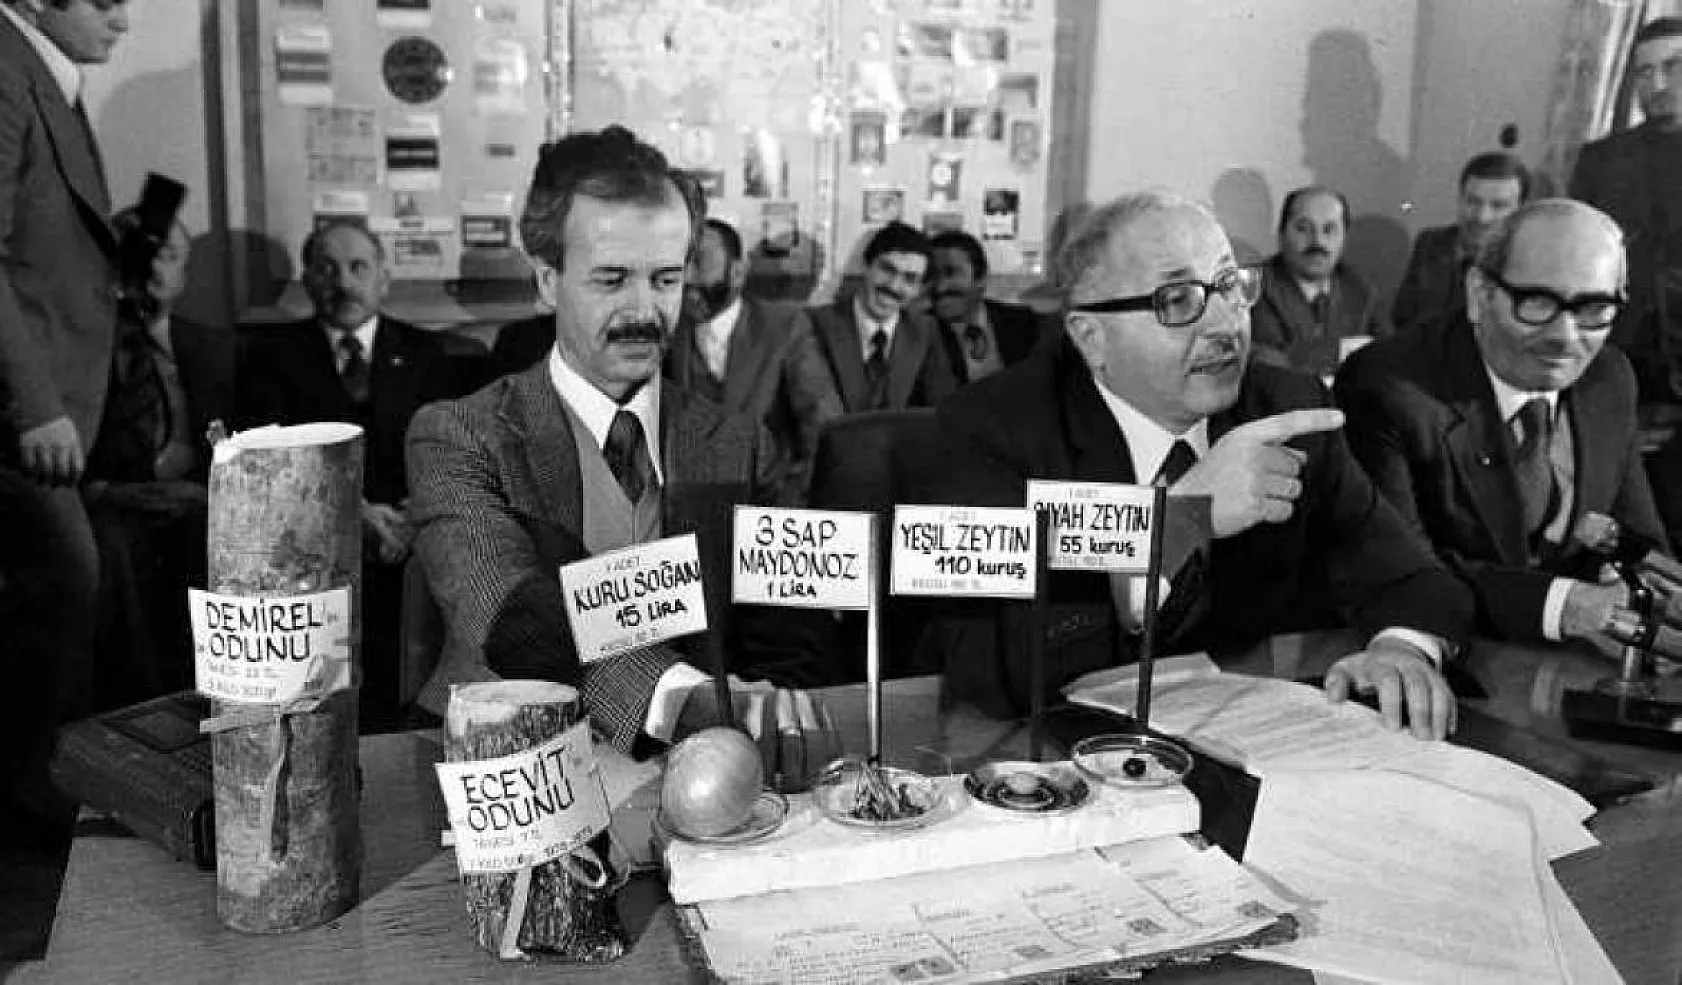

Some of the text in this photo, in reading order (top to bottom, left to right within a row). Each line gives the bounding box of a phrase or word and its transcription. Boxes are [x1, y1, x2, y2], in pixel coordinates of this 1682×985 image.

[756, 514, 837, 548] 3 SAP
[1061, 535, 1083, 555] 55
[739, 547, 860, 580] MAYDONOZ
[935, 555, 972, 575] 110
[573, 559, 701, 615] KURU SOĞAN
[767, 581, 775, 599] 1
[615, 604, 642, 629] 15
[210, 632, 310, 663] ODUNU
[467, 776, 576, 831] ODUNU
